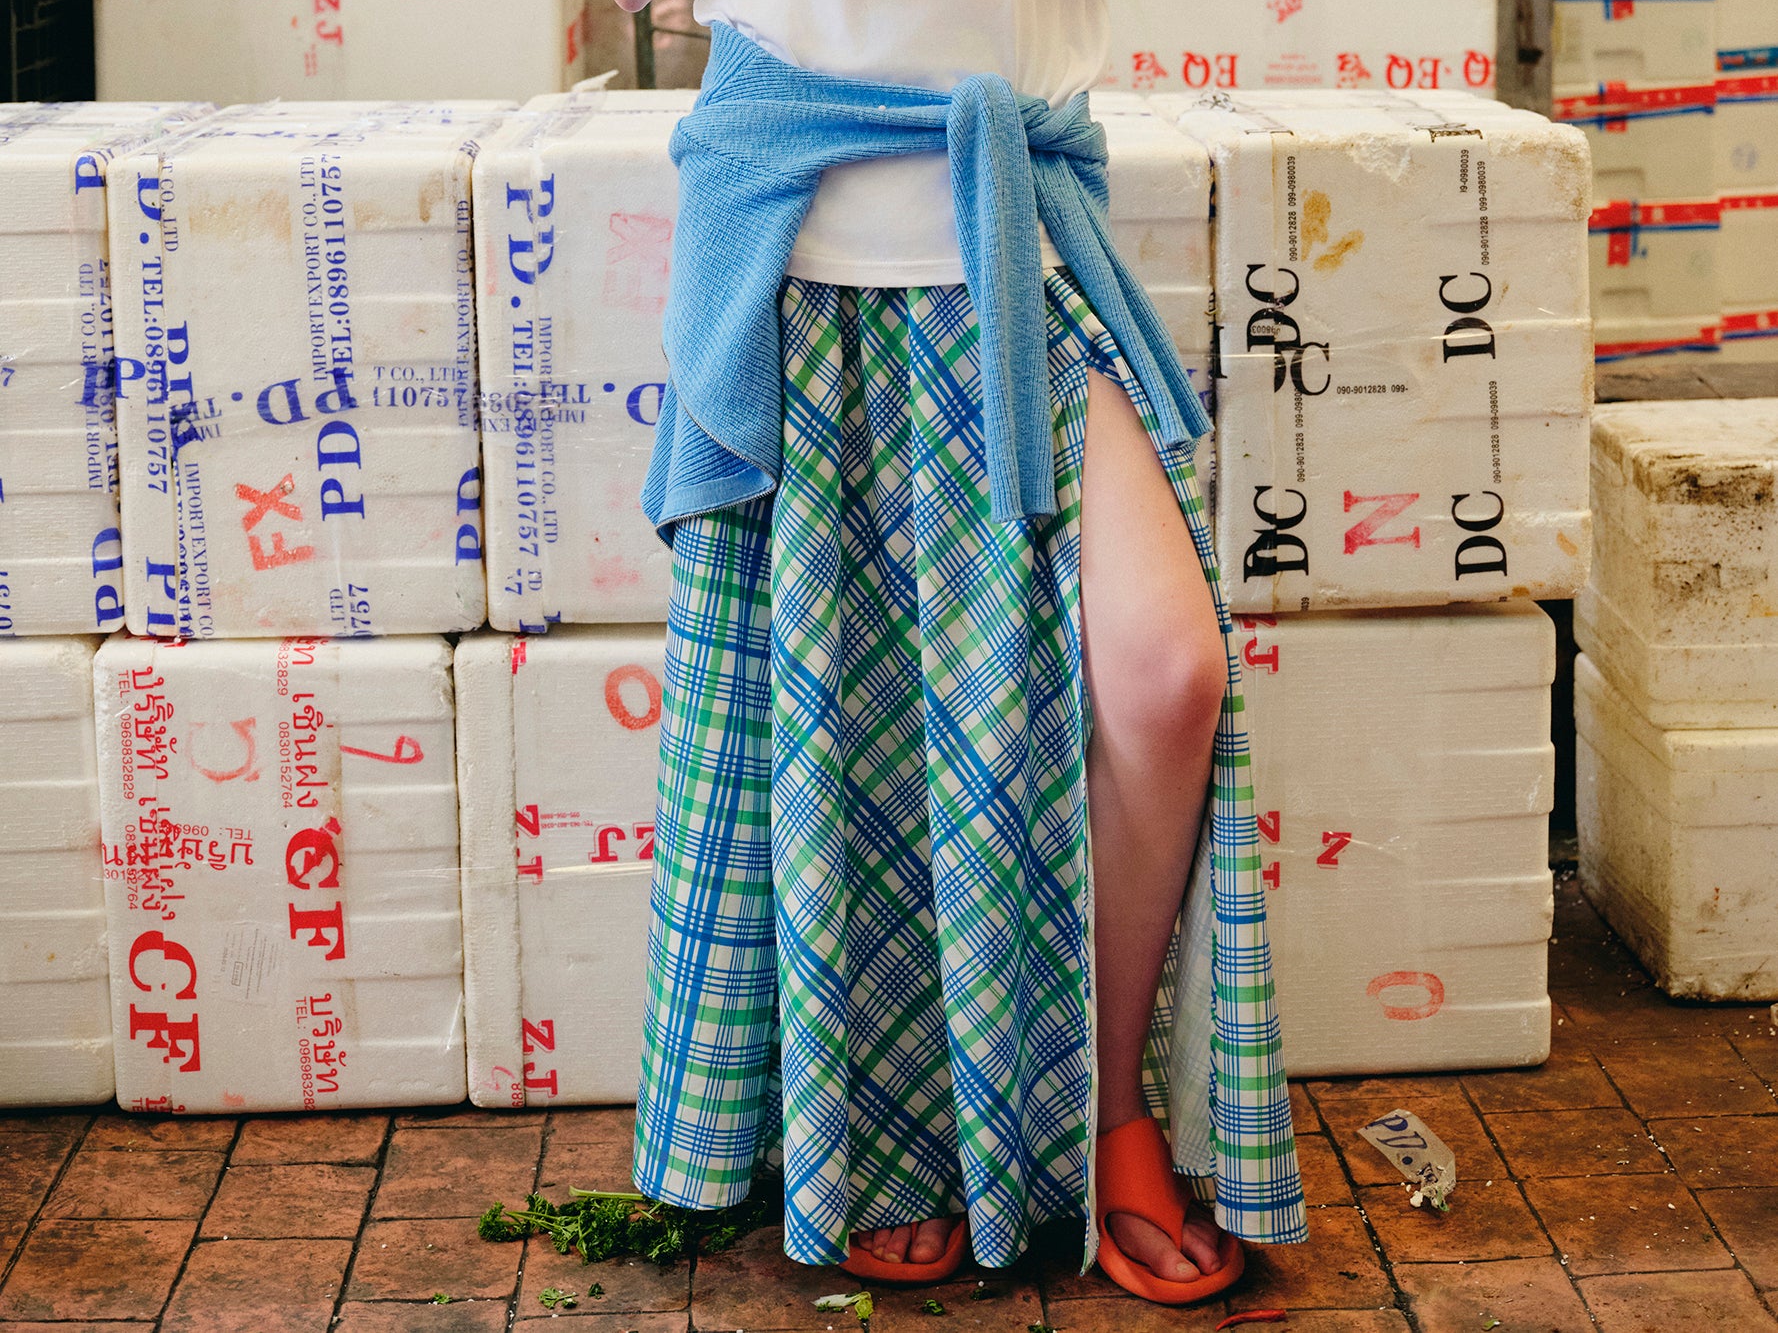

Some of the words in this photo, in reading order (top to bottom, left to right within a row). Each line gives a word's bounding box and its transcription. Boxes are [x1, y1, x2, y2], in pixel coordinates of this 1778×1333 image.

[1182, 52, 1239, 88] EQ
[1386, 54, 1441, 89] EQ
[1477, 160, 1487, 211] 099-0980039
[304, 232, 323, 307] EXPORT
[1479, 215, 1490, 265] 090-9012828
[1439, 272, 1496, 363] DC
[1336, 384, 1387, 394] 090-9012828
[1489, 380, 1499, 430] 099-0980039
[317, 421, 365, 521] PD
[1491, 434, 1501, 484] 090-9012828
[1451, 490, 1508, 580] DC
[121, 712, 135, 801] 0969832829
[278, 721, 293, 809] 0830152764
[310, 992, 347, 1093] บริษัท
